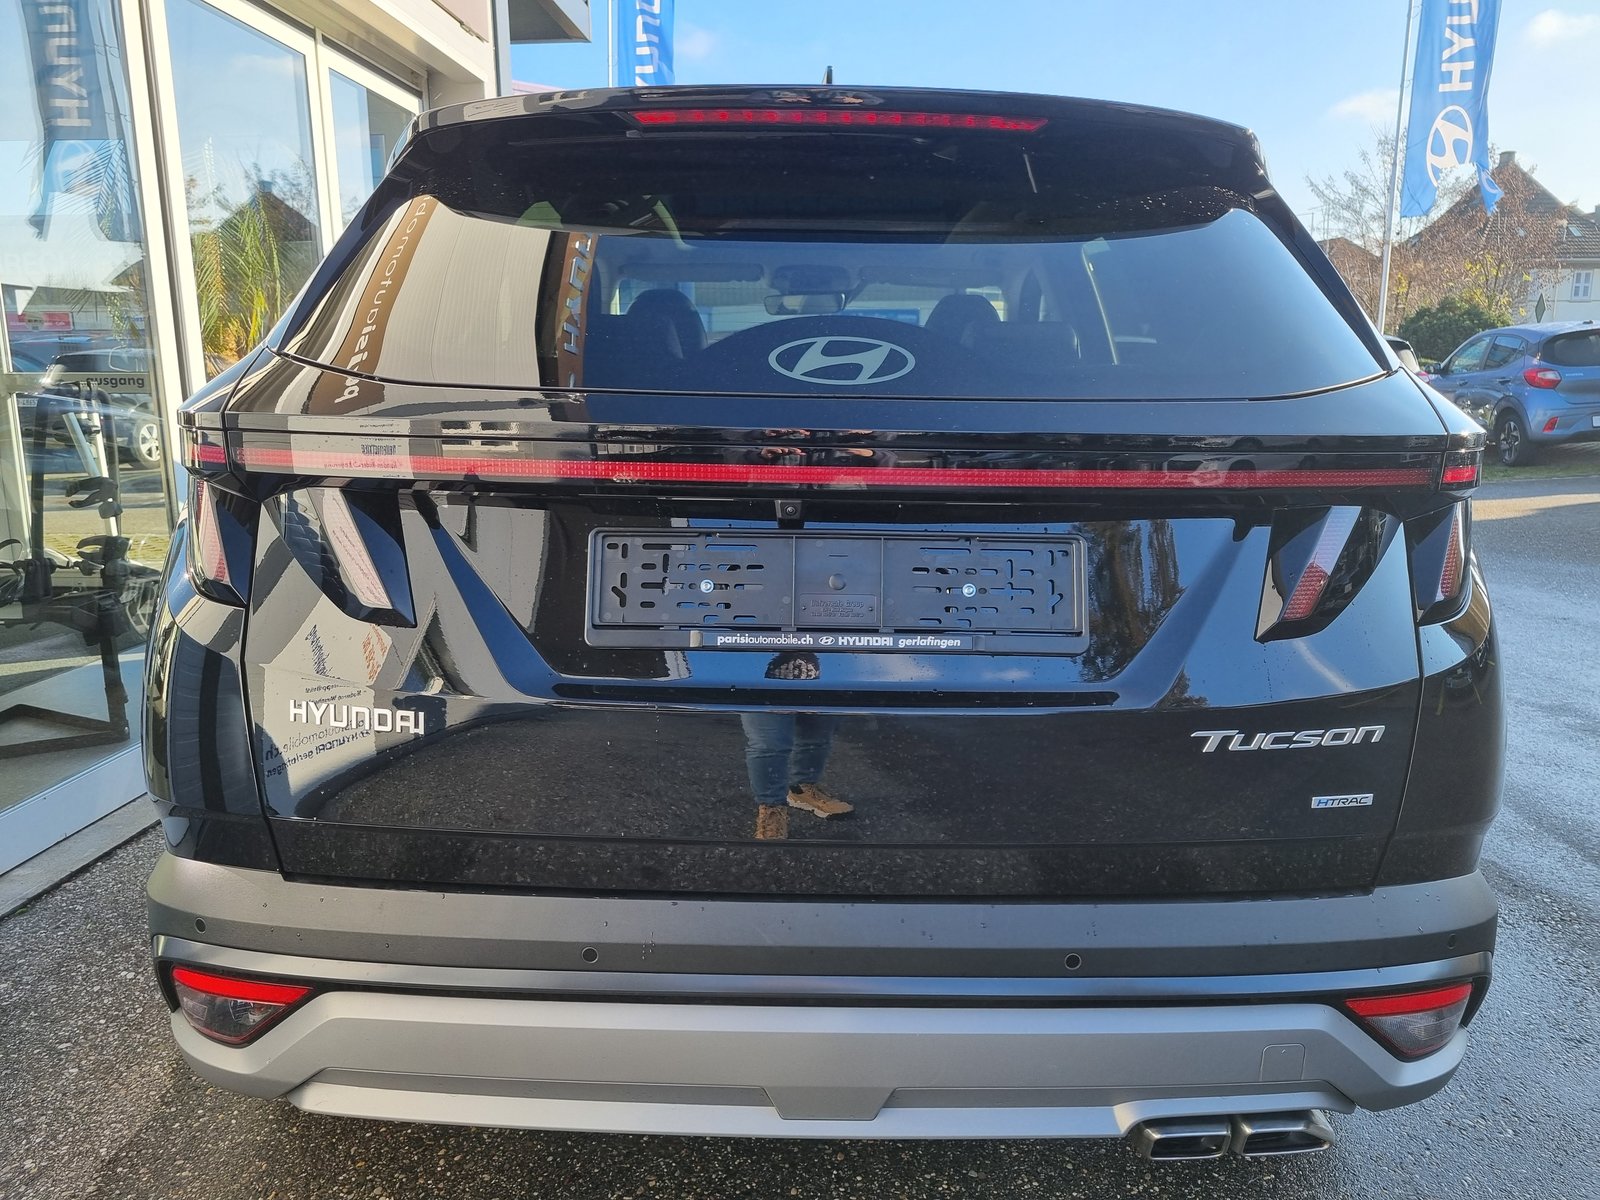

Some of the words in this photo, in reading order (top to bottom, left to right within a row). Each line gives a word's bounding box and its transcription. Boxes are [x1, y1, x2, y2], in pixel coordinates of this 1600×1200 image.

[717, 634, 814, 646] parisiautomobile.ch
[838, 636, 893, 647] HYUNDAI
[898, 636, 961, 648] gerlafingen
[288, 699, 426, 736] HYUNDAI
[1315, 795, 1371, 808] HTRAC
